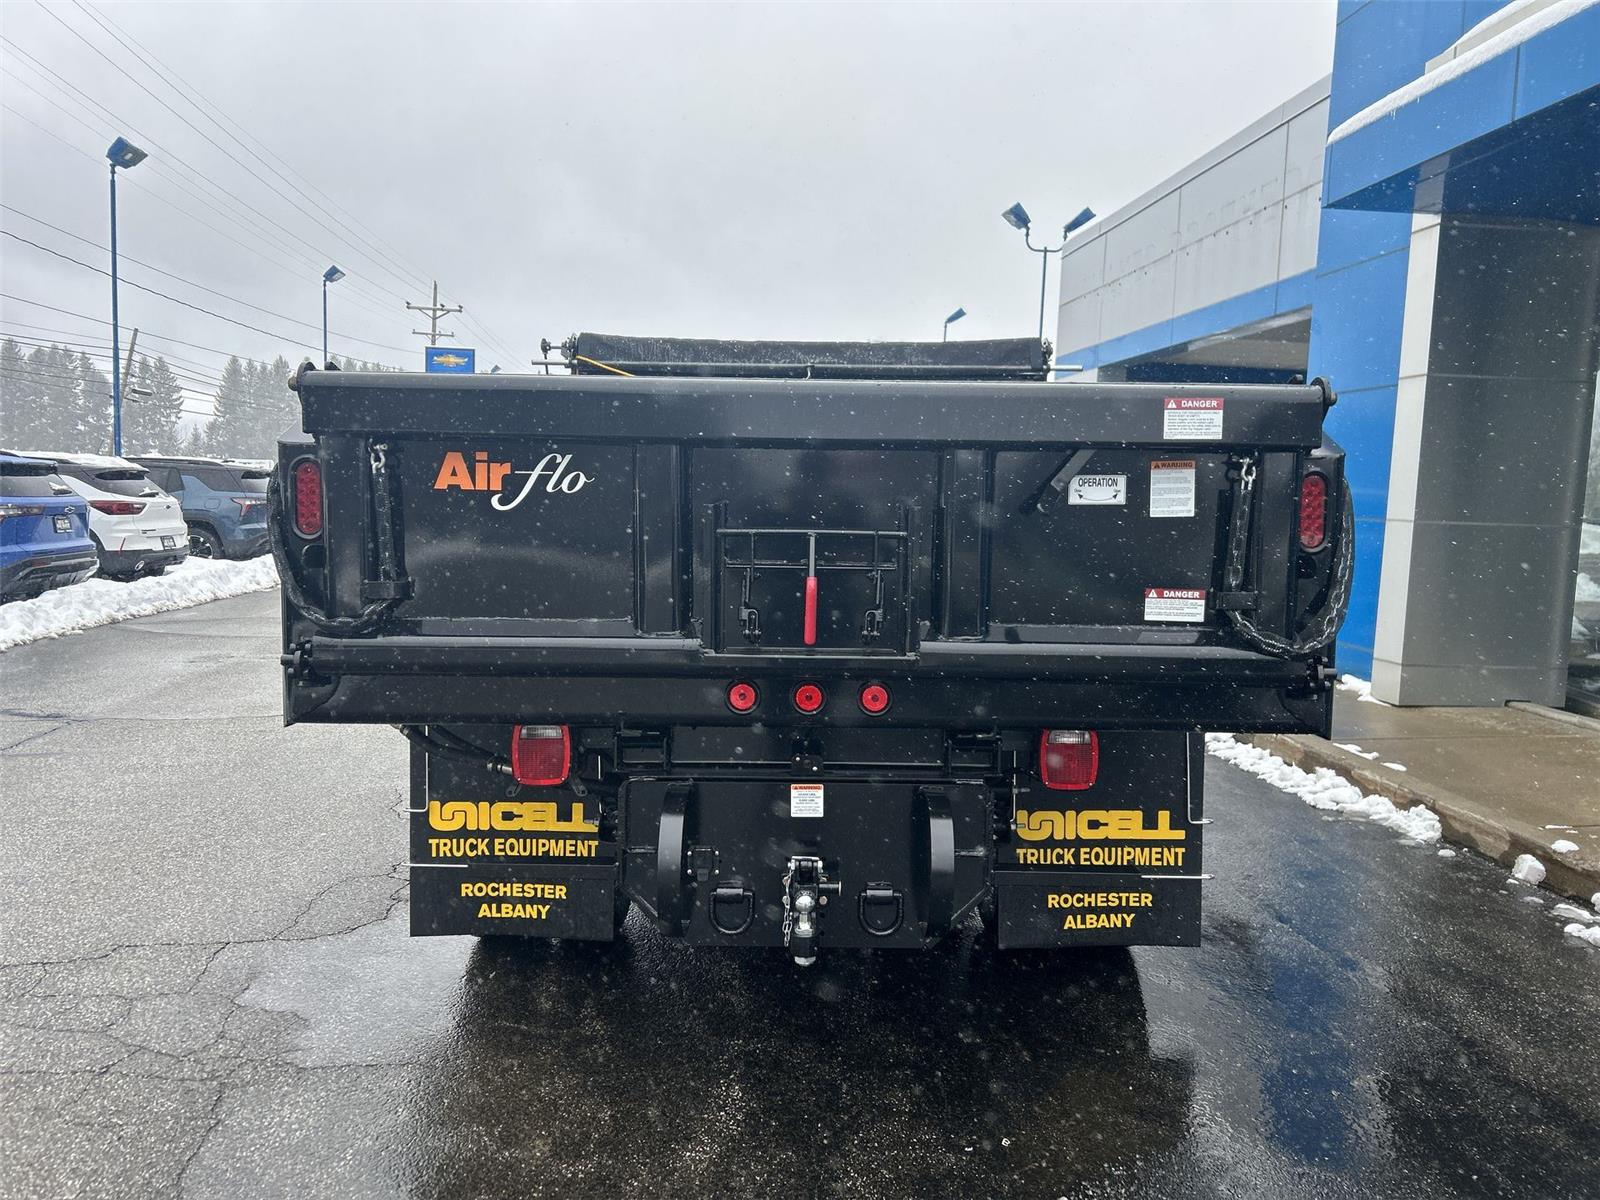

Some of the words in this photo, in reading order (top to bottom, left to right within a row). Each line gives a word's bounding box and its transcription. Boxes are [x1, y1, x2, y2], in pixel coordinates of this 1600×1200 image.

[1181, 400, 1218, 408] DANGER
[1078, 477, 1118, 487] OPERATION
[1163, 590, 1200, 599] DANGER
[428, 800, 599, 833] UNICELL
[1016, 810, 1186, 841] UNICELL
[428, 838, 490, 857] TRUCK
[494, 838, 599, 857] EQUIPMENT
[1016, 847, 1076, 865] TRUCK
[1080, 846, 1186, 866] EQUIPMENT
[460, 883, 567, 899] ROCHESTER
[1047, 892, 1153, 908] ROCHESTER
[478, 903, 551, 919] ALBANY
[1063, 913, 1136, 930] ALBANY
